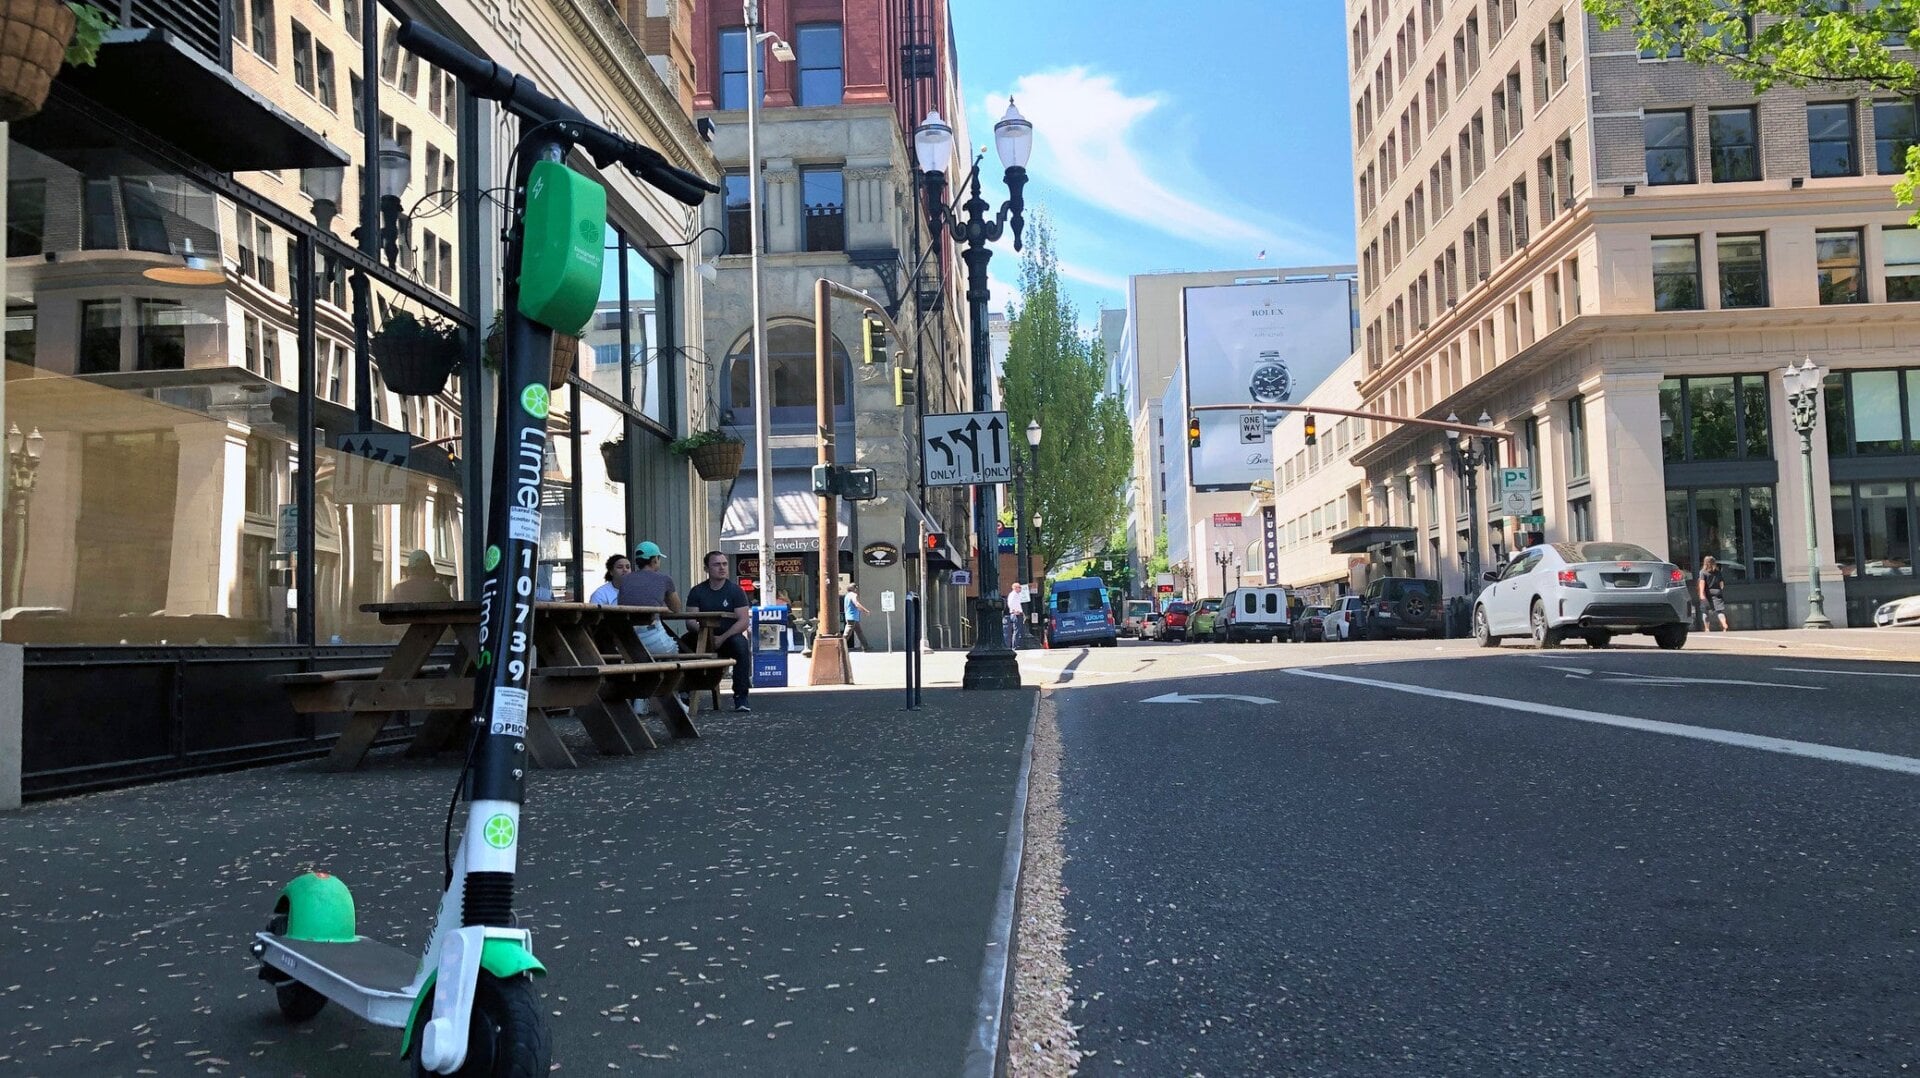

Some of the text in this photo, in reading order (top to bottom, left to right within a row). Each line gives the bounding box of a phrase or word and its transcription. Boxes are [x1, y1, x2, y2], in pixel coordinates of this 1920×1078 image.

[1243, 416, 1260, 424] ONE
[517, 427, 547, 510] Lime
[930, 469, 956, 480] ONLY
[984, 466, 1010, 478] ONLY
[1505, 471, 1517, 488] P
[739, 542, 760, 551] Esta
[1266, 511, 1276, 580] LUGGAGE
[508, 549, 532, 681] 10739
